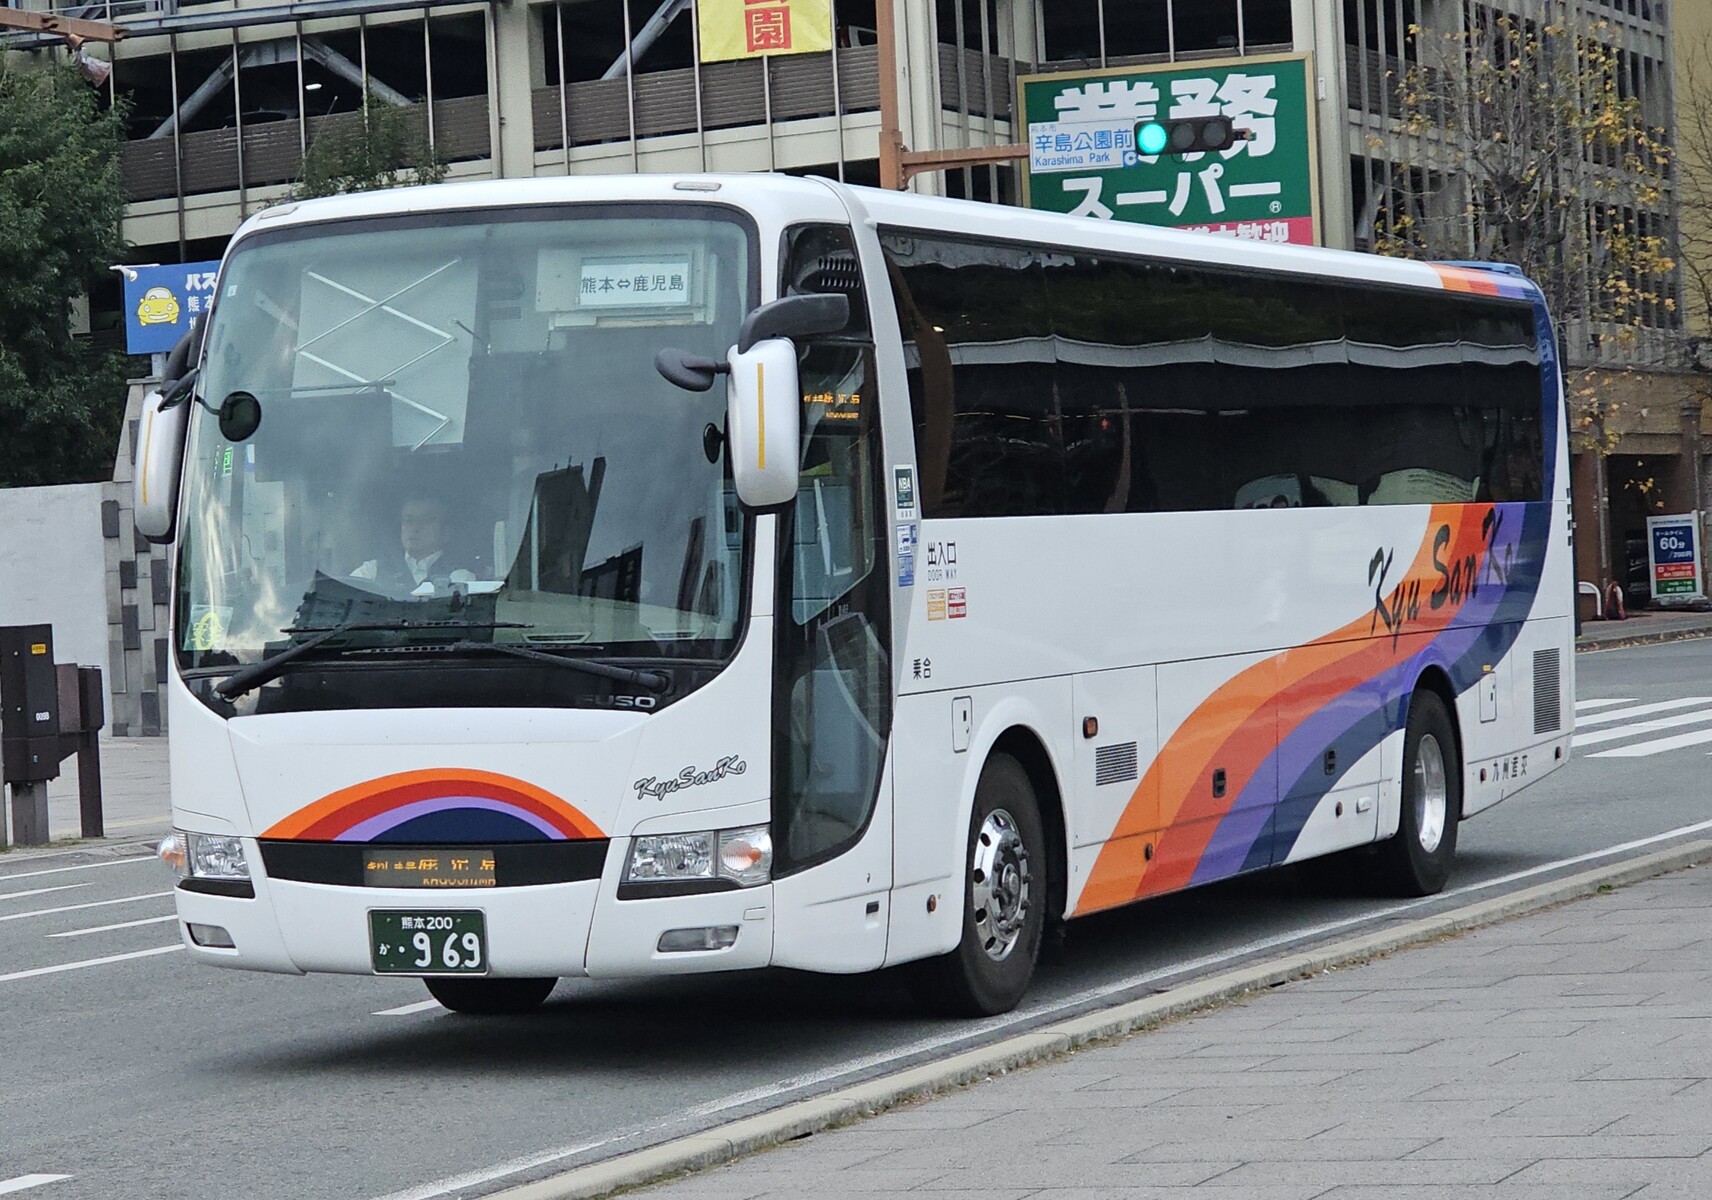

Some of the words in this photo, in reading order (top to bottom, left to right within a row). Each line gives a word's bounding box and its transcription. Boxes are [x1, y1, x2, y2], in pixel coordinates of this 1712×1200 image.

[744, 0, 791, 52] 園
[1035, 129, 1132, 153] 辛島公園前
[1035, 154, 1084, 167] Karashima
[1089, 152, 1110, 162] Park
[1062, 163, 1281, 220] スーパー
[581, 276, 615, 293] 熊本
[633, 274, 684, 291] 鹿児島
[927, 541, 957, 566] 出入口
[945, 569, 957, 580] WAY
[1368, 546, 1421, 655] Kyu
[1430, 523, 1477, 610] San
[1482, 507, 1514, 586] Ko
[379, 943, 391, 955] か
